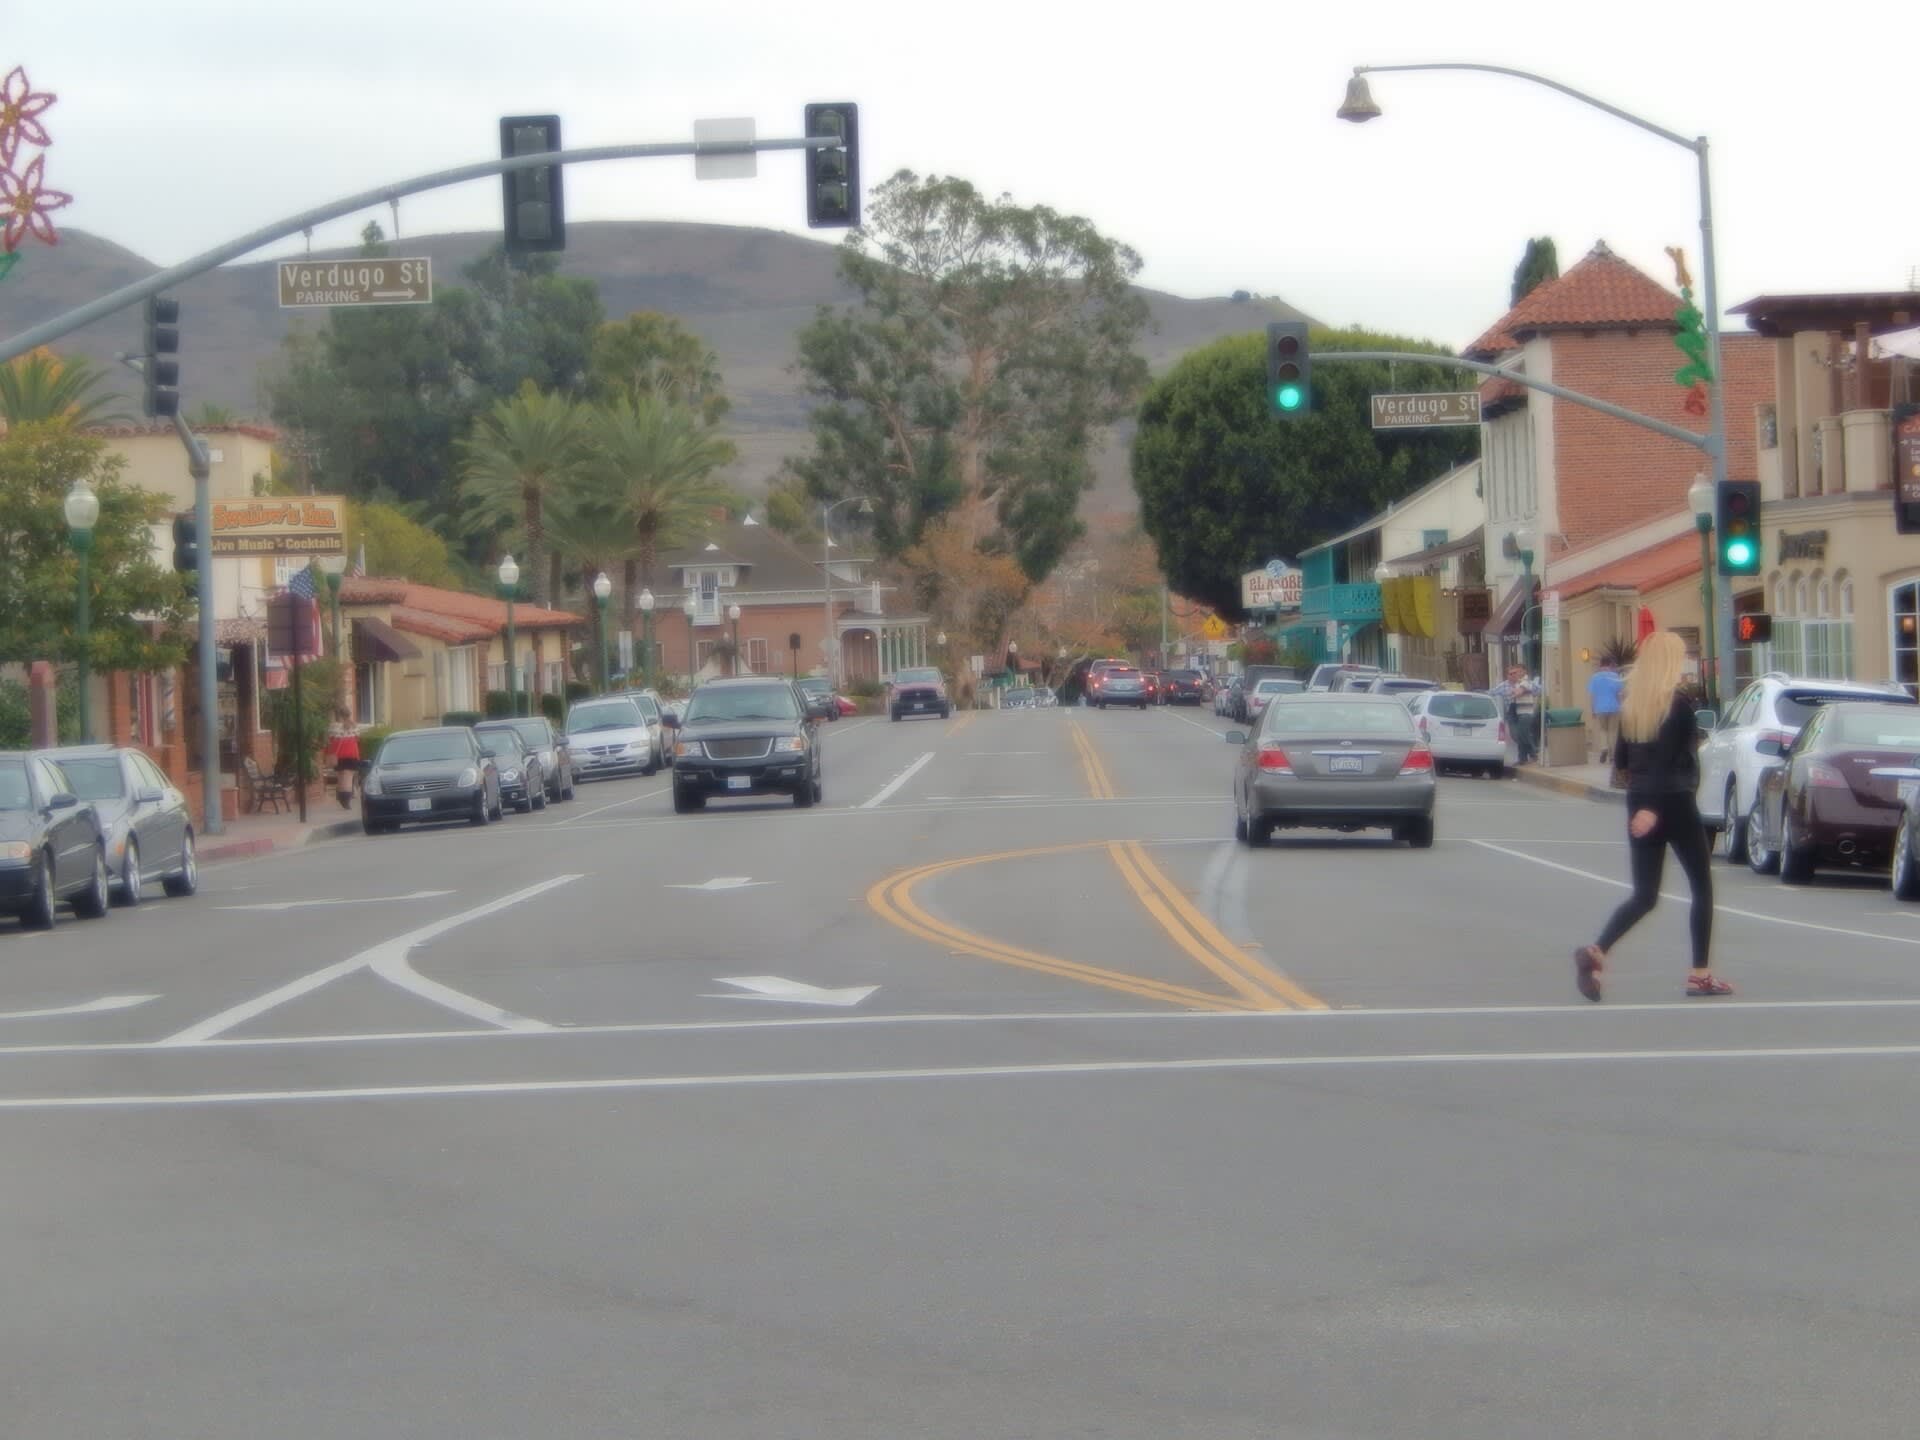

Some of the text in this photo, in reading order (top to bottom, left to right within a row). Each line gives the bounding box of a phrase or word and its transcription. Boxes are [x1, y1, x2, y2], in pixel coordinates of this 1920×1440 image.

[285, 262, 425, 292] Verdugo St
[296, 290, 360, 303] PARKING
[1376, 395, 1477, 416] Verdugo St
[1384, 414, 1431, 425] PARKING
[238, 538, 275, 550] Music
[285, 537, 341, 549] Cocktails
